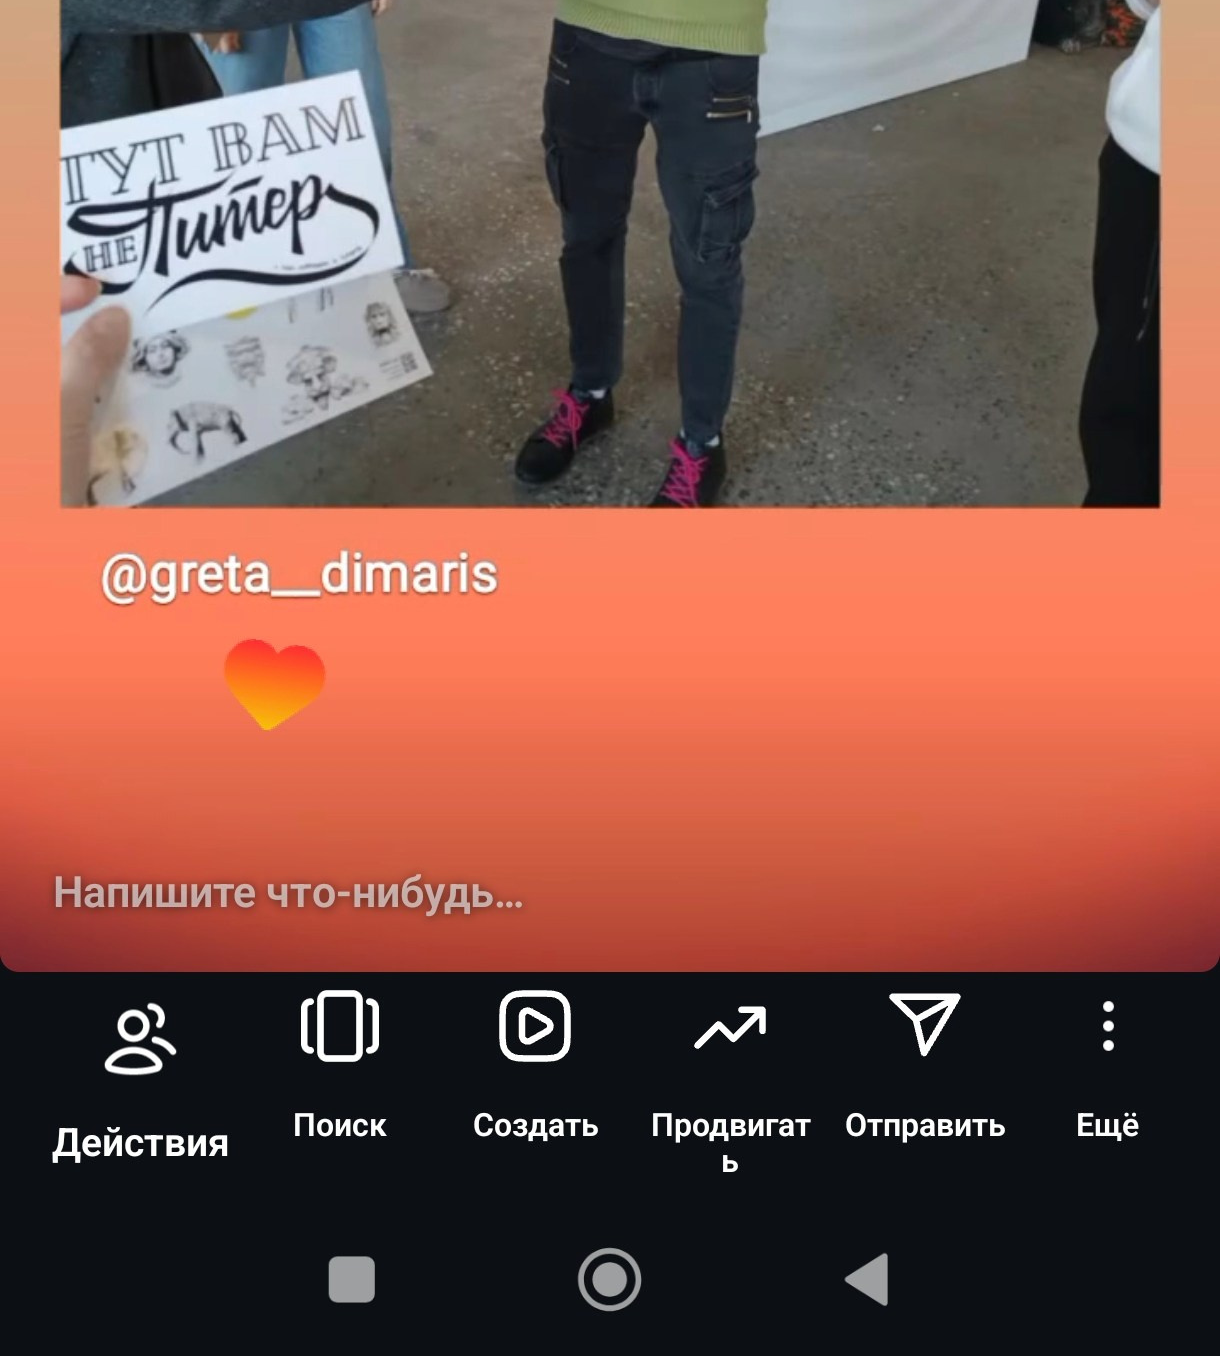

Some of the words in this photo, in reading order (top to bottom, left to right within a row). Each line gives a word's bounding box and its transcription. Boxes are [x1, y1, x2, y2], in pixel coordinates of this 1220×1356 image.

[61, 132, 186, 206] ТУТ
[207, 96, 366, 173] ВАМ
[66, 172, 380, 286] Питер
[82, 234, 138, 273] НЕ
